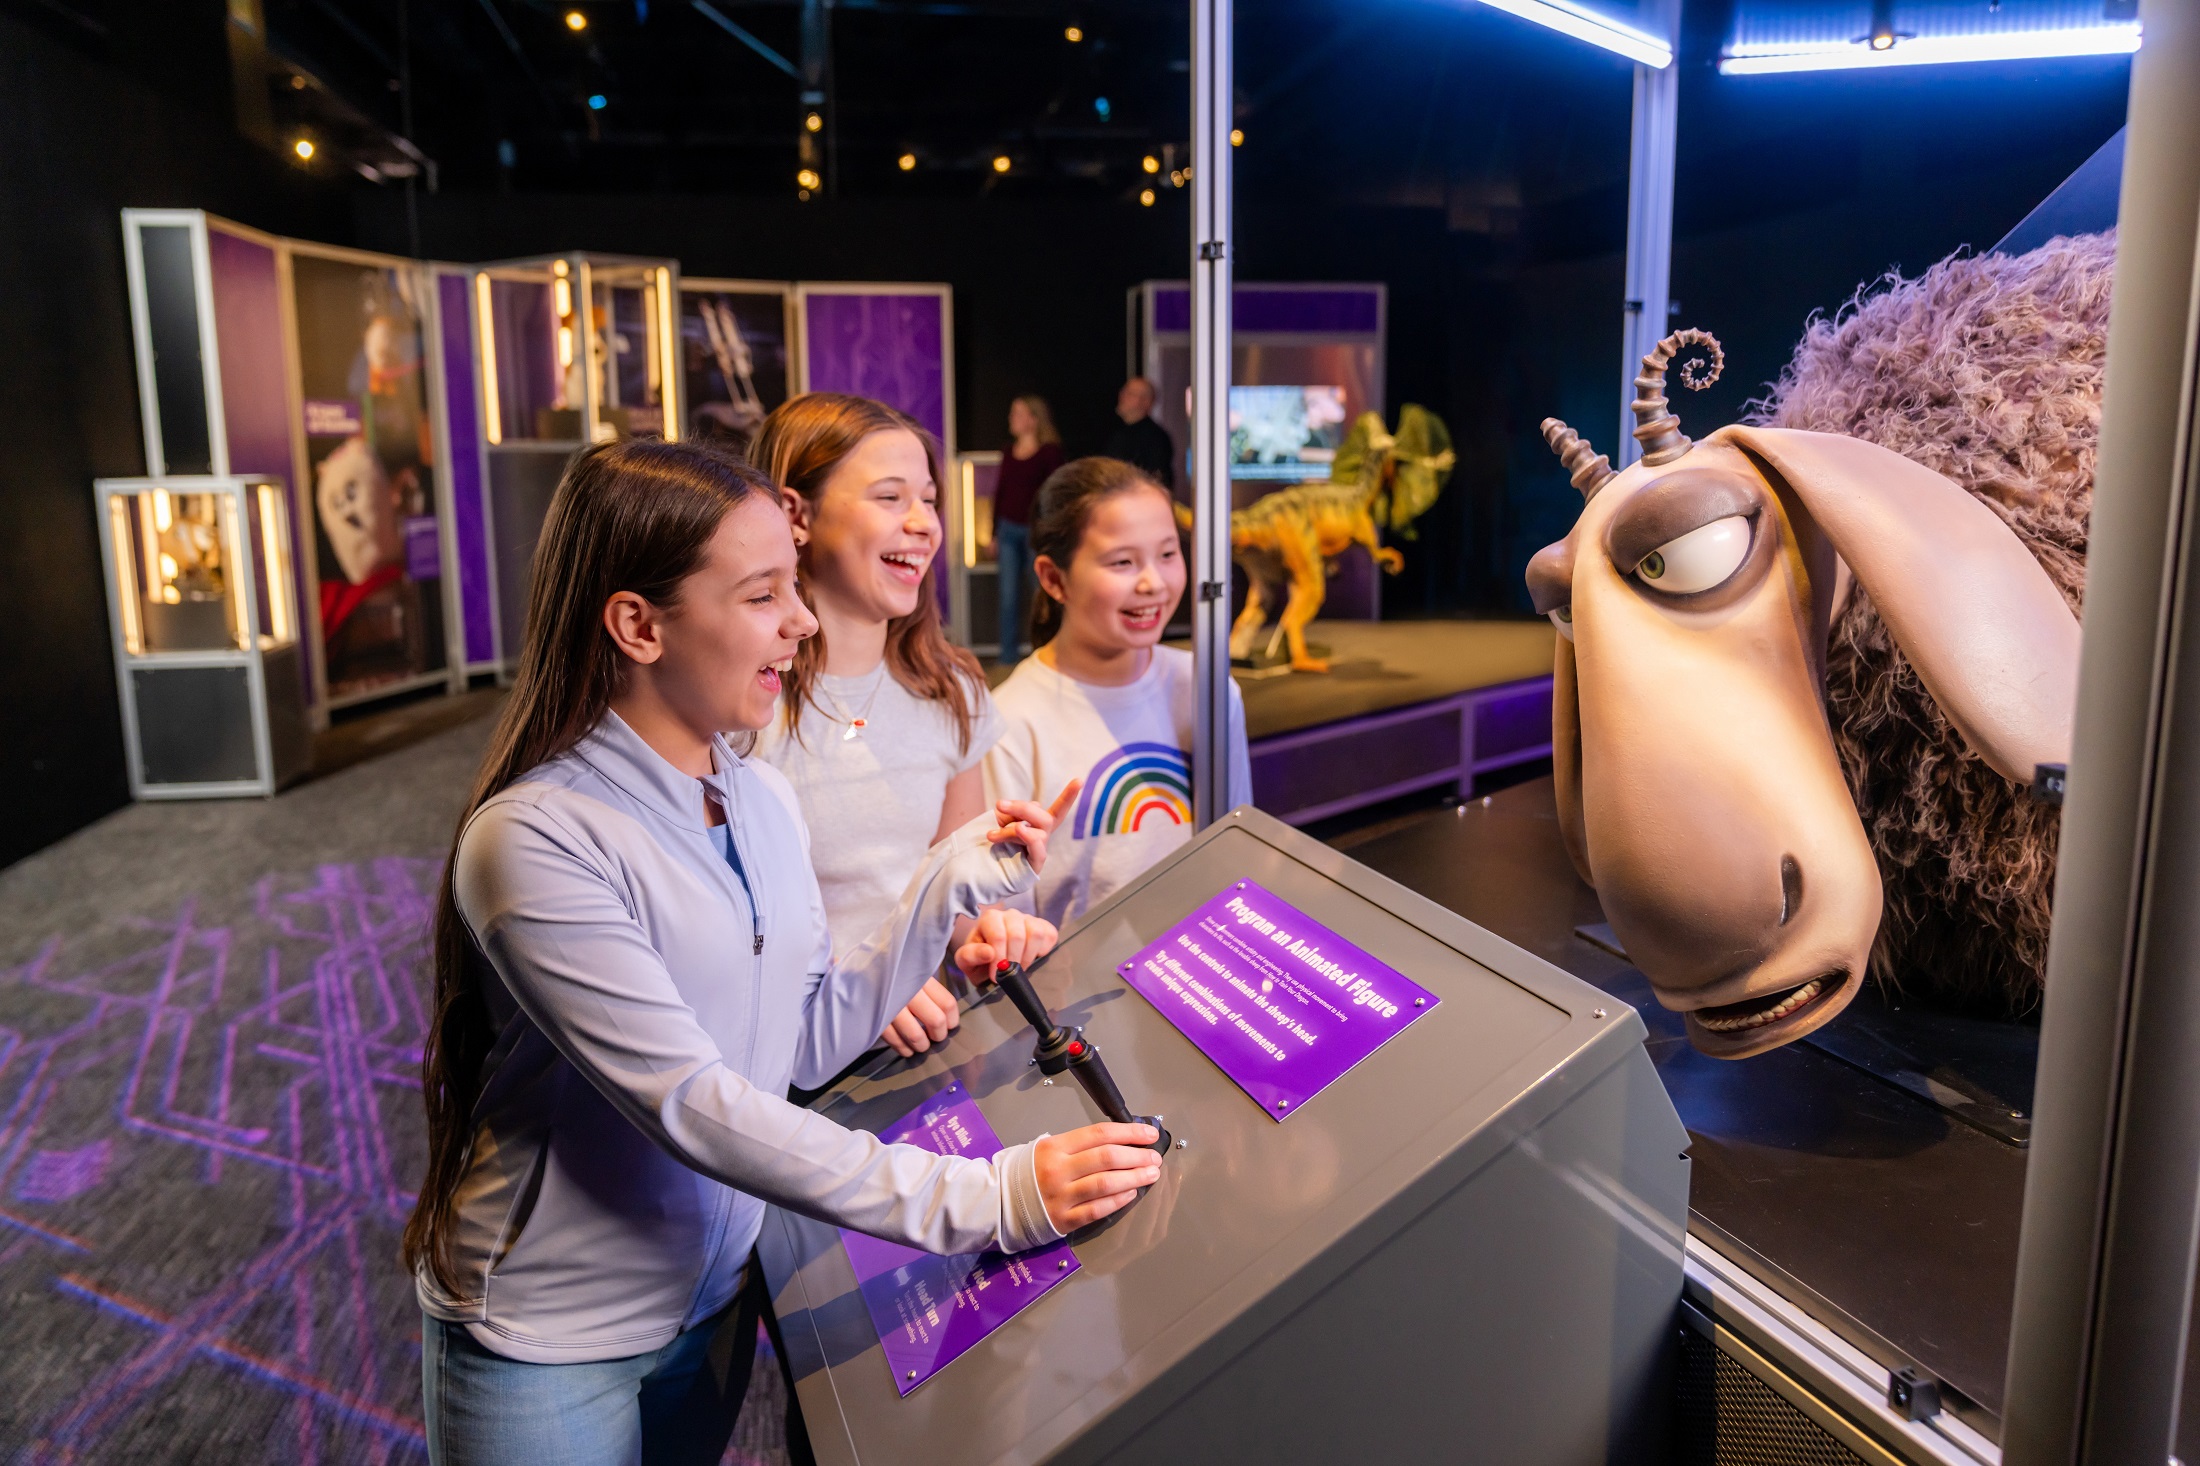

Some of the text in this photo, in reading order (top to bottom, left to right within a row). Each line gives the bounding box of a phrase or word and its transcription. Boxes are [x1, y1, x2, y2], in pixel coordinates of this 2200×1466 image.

[1222, 896, 1401, 1020] Program an Animated Figure
[1143, 959, 1220, 1026] create unique expressions.
[1153, 949, 1287, 1061] Try different combinations of movements to
[1176, 933, 1318, 1046] Use the controls to animate the sheep's head.
[1247, 959, 1261, 969] sheep
[1258, 965, 1269, 974] from
[1265, 971, 1276, 980] How
[1277, 979, 1289, 989] Train
[1285, 985, 1296, 994] Your
[1292, 991, 1310, 1006] Dragon.
[1255, 953, 1266, 961] and
[1281, 971, 1293, 982] They
[1295, 983, 1315, 996] physical
[1310, 993, 1333, 1010] movement
[1333, 1009, 1349, 1022] bring
[945, 1115, 972, 1148] Eye Blink
[972, 1267, 991, 1291] Nod
[1016, 1260, 1031, 1278] eyelids
[1026, 1275, 1033, 1283] to
[914, 1279, 940, 1327] Head Turn
[967, 1292, 977, 1305] react
[901, 1316, 917, 1344] something.
[918, 1324, 927, 1338] react
